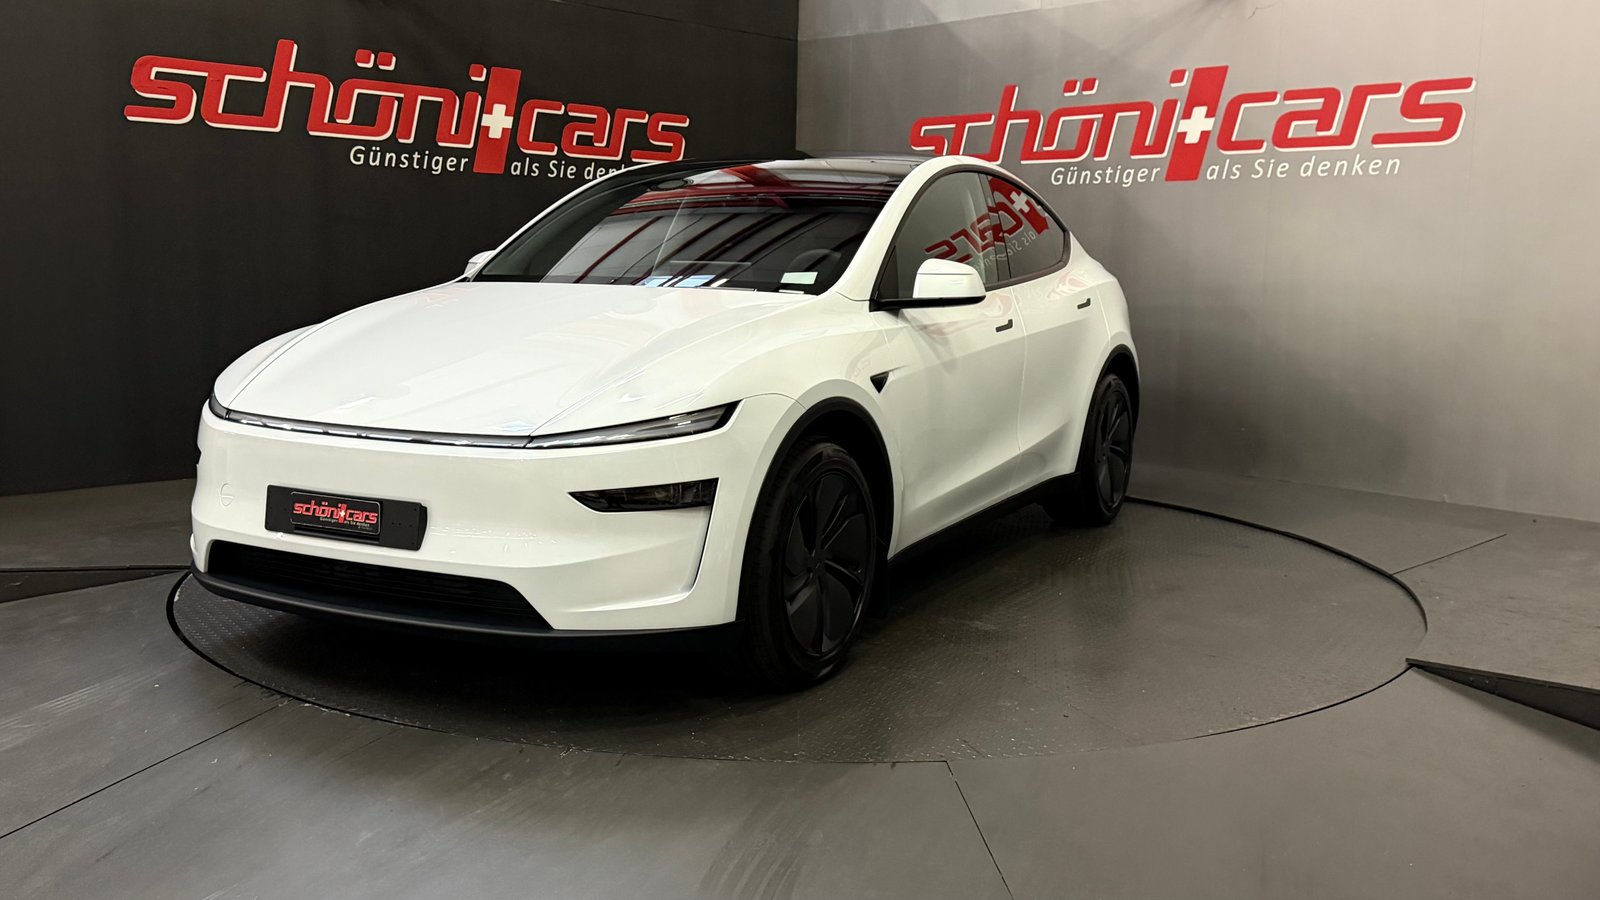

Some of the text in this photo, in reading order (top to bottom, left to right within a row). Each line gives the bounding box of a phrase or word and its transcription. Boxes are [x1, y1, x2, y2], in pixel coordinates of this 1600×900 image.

[349, 145, 469, 175] Günstiger
[510, 157, 540, 177] als
[547, 160, 577, 179] Sie
[1051, 153, 1400, 188] Günstiger als Sie denken
